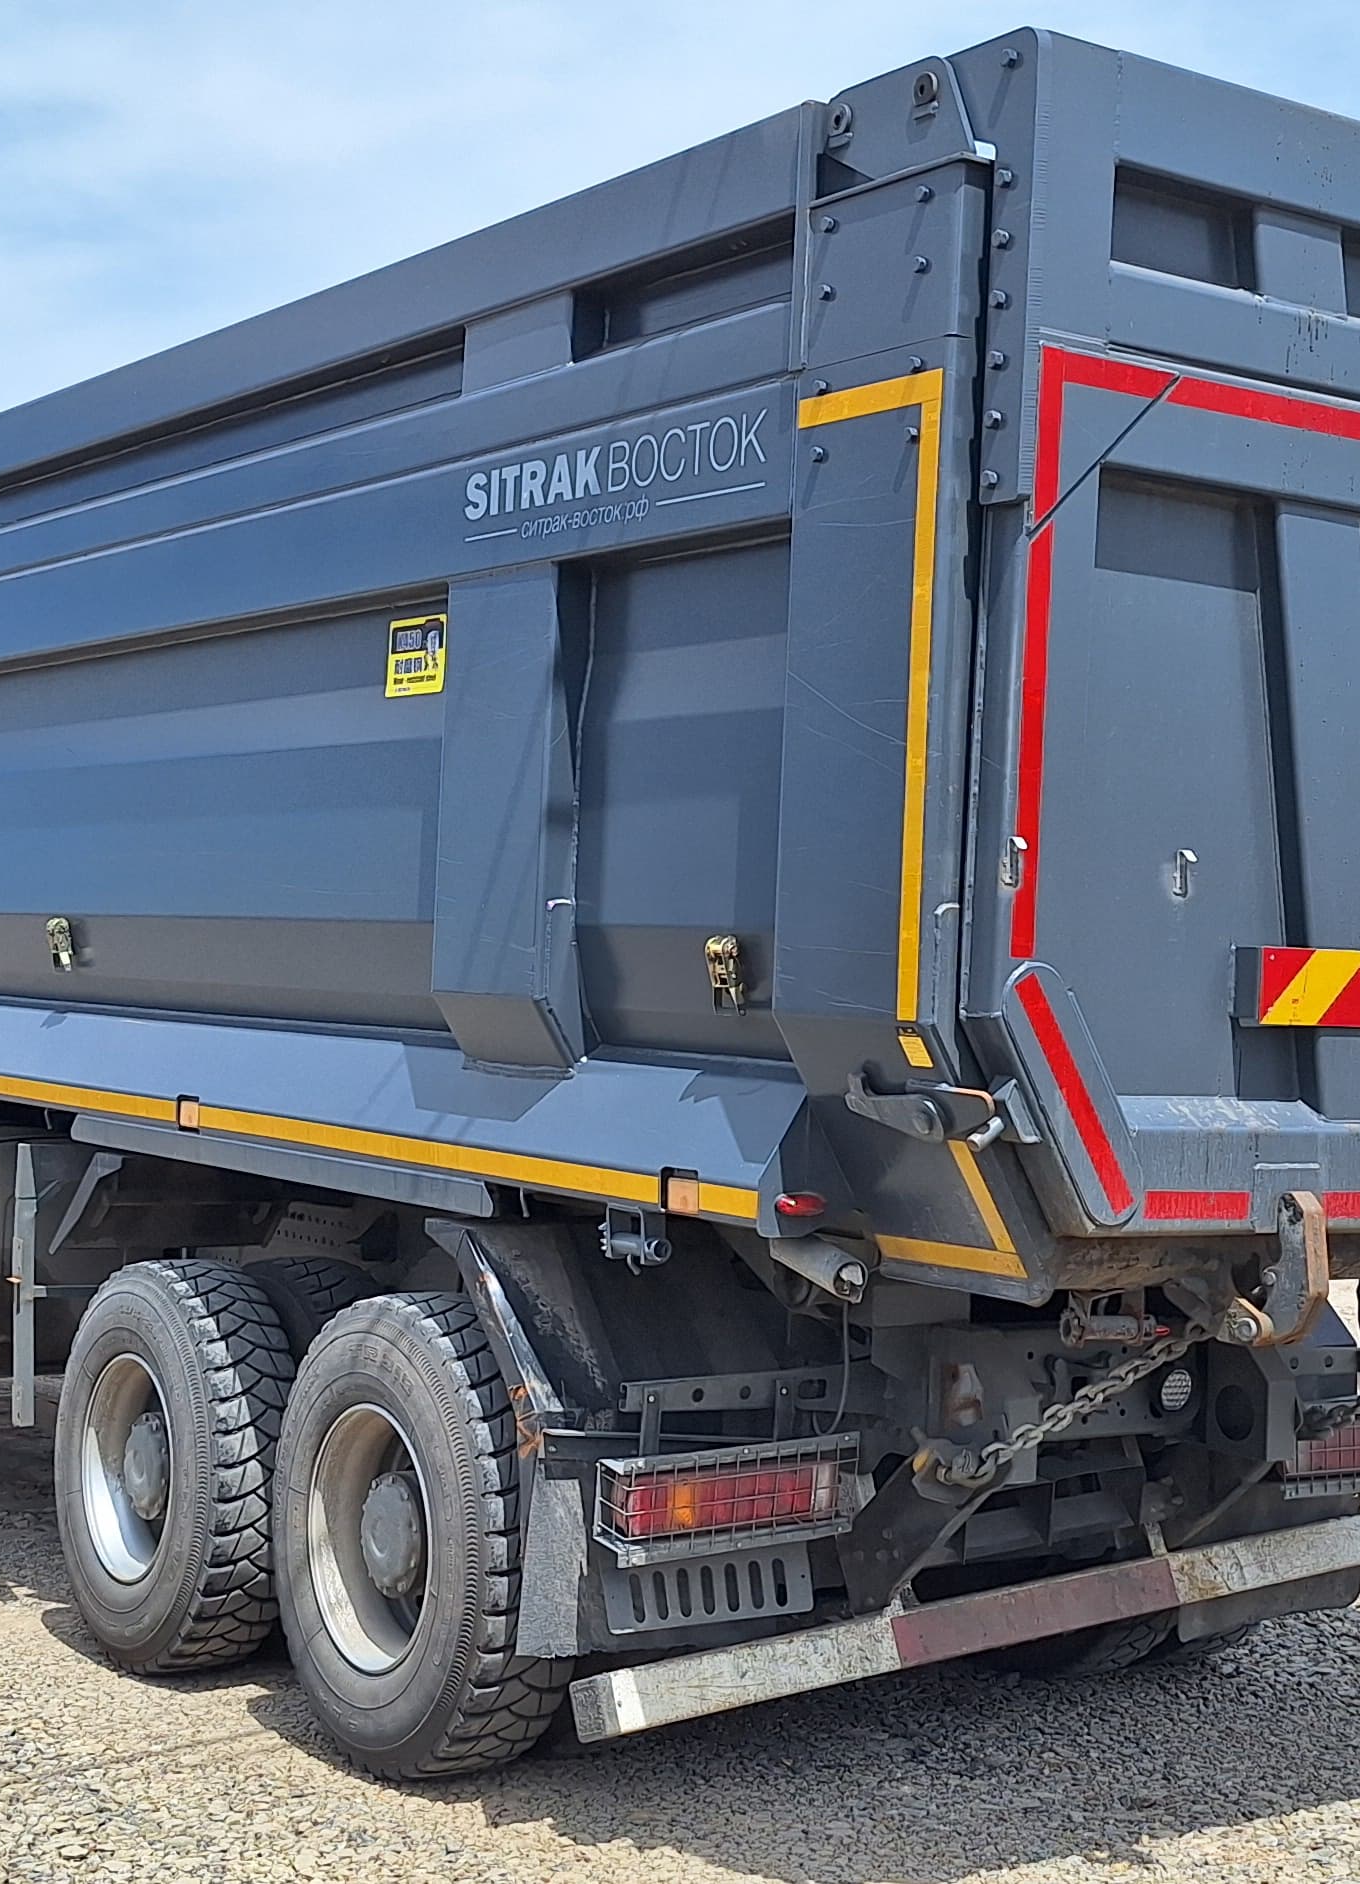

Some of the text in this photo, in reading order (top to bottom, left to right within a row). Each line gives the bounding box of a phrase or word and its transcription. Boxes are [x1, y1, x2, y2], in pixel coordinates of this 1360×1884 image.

[464, 446, 601, 521] SITRAK
[607, 408, 768, 493] ВОСТОК
[520, 495, 650, 539] ситрак-восток.рф
